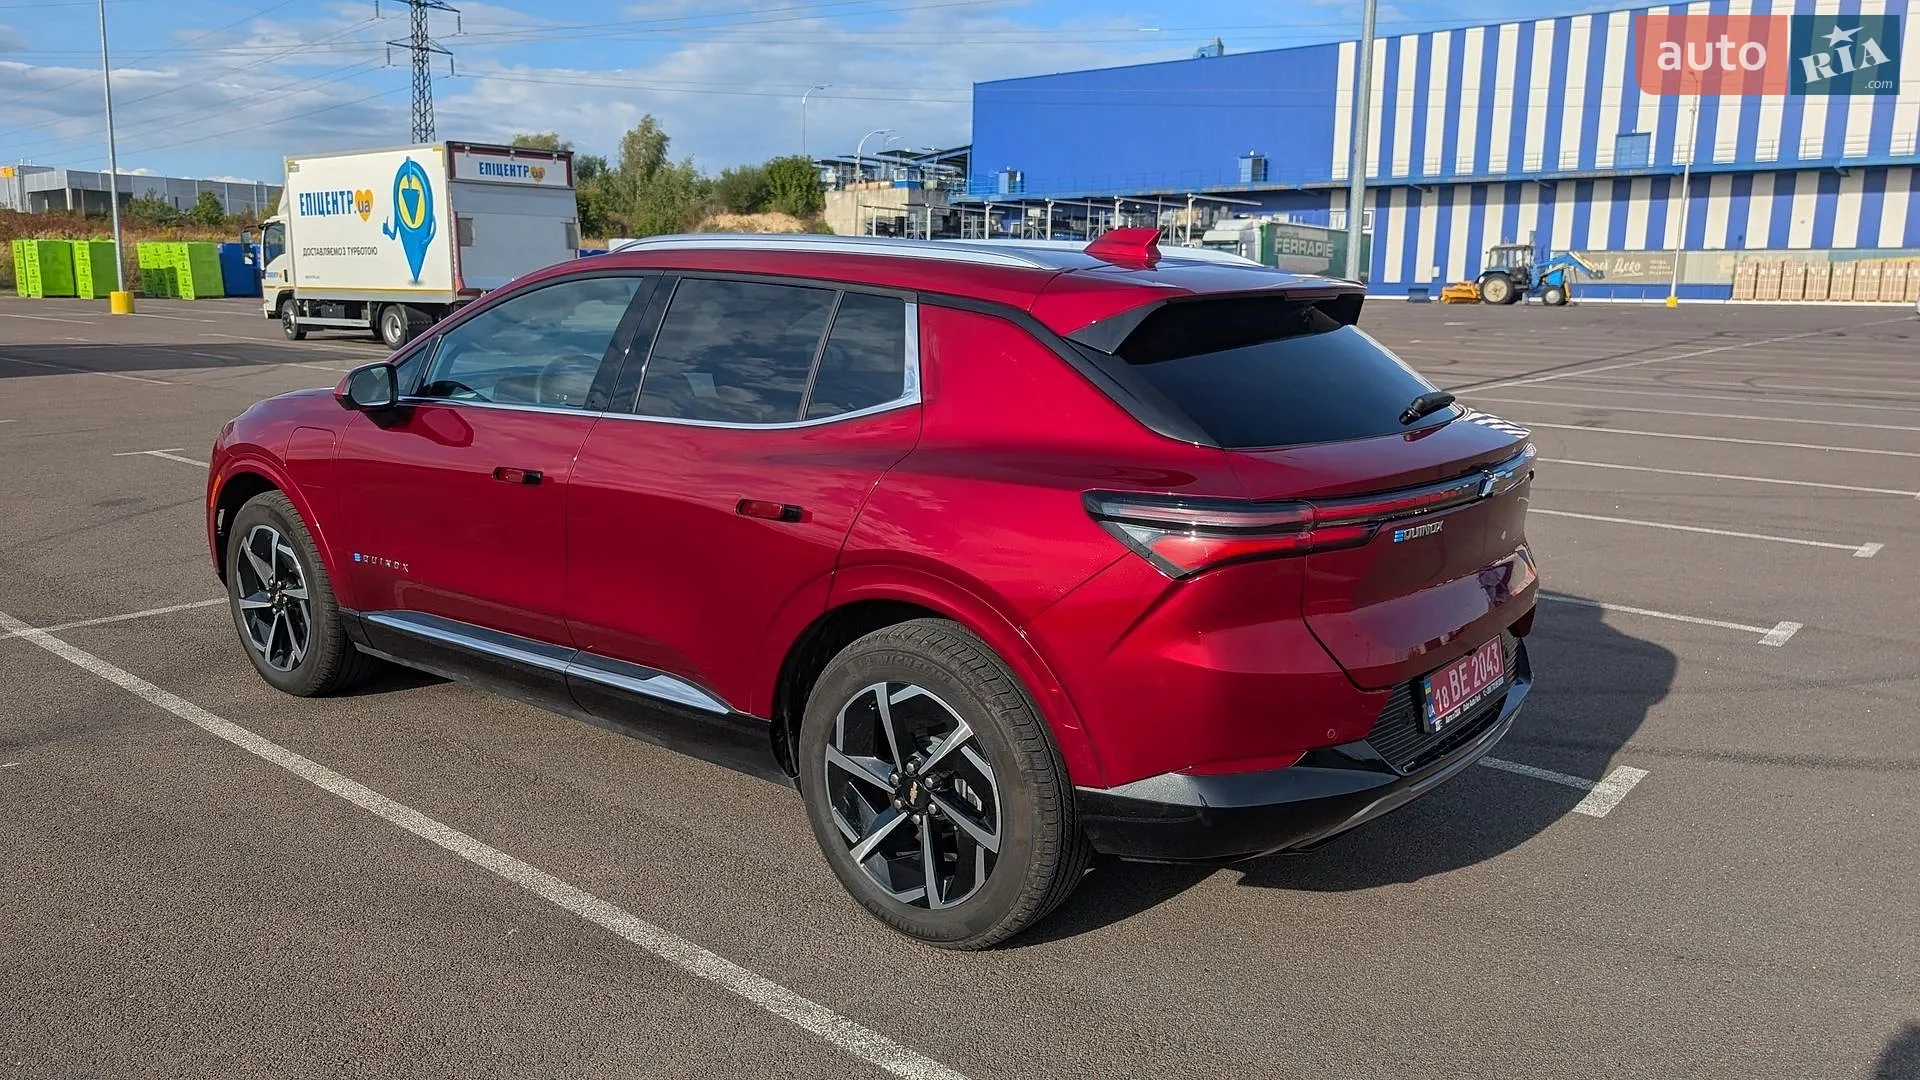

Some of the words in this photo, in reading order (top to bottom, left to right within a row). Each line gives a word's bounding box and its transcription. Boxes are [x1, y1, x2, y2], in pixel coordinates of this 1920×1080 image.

[1435, 686, 1450, 712] 18
[1449, 662, 1470, 702] BE
[1471, 643, 1499, 687] 2043
